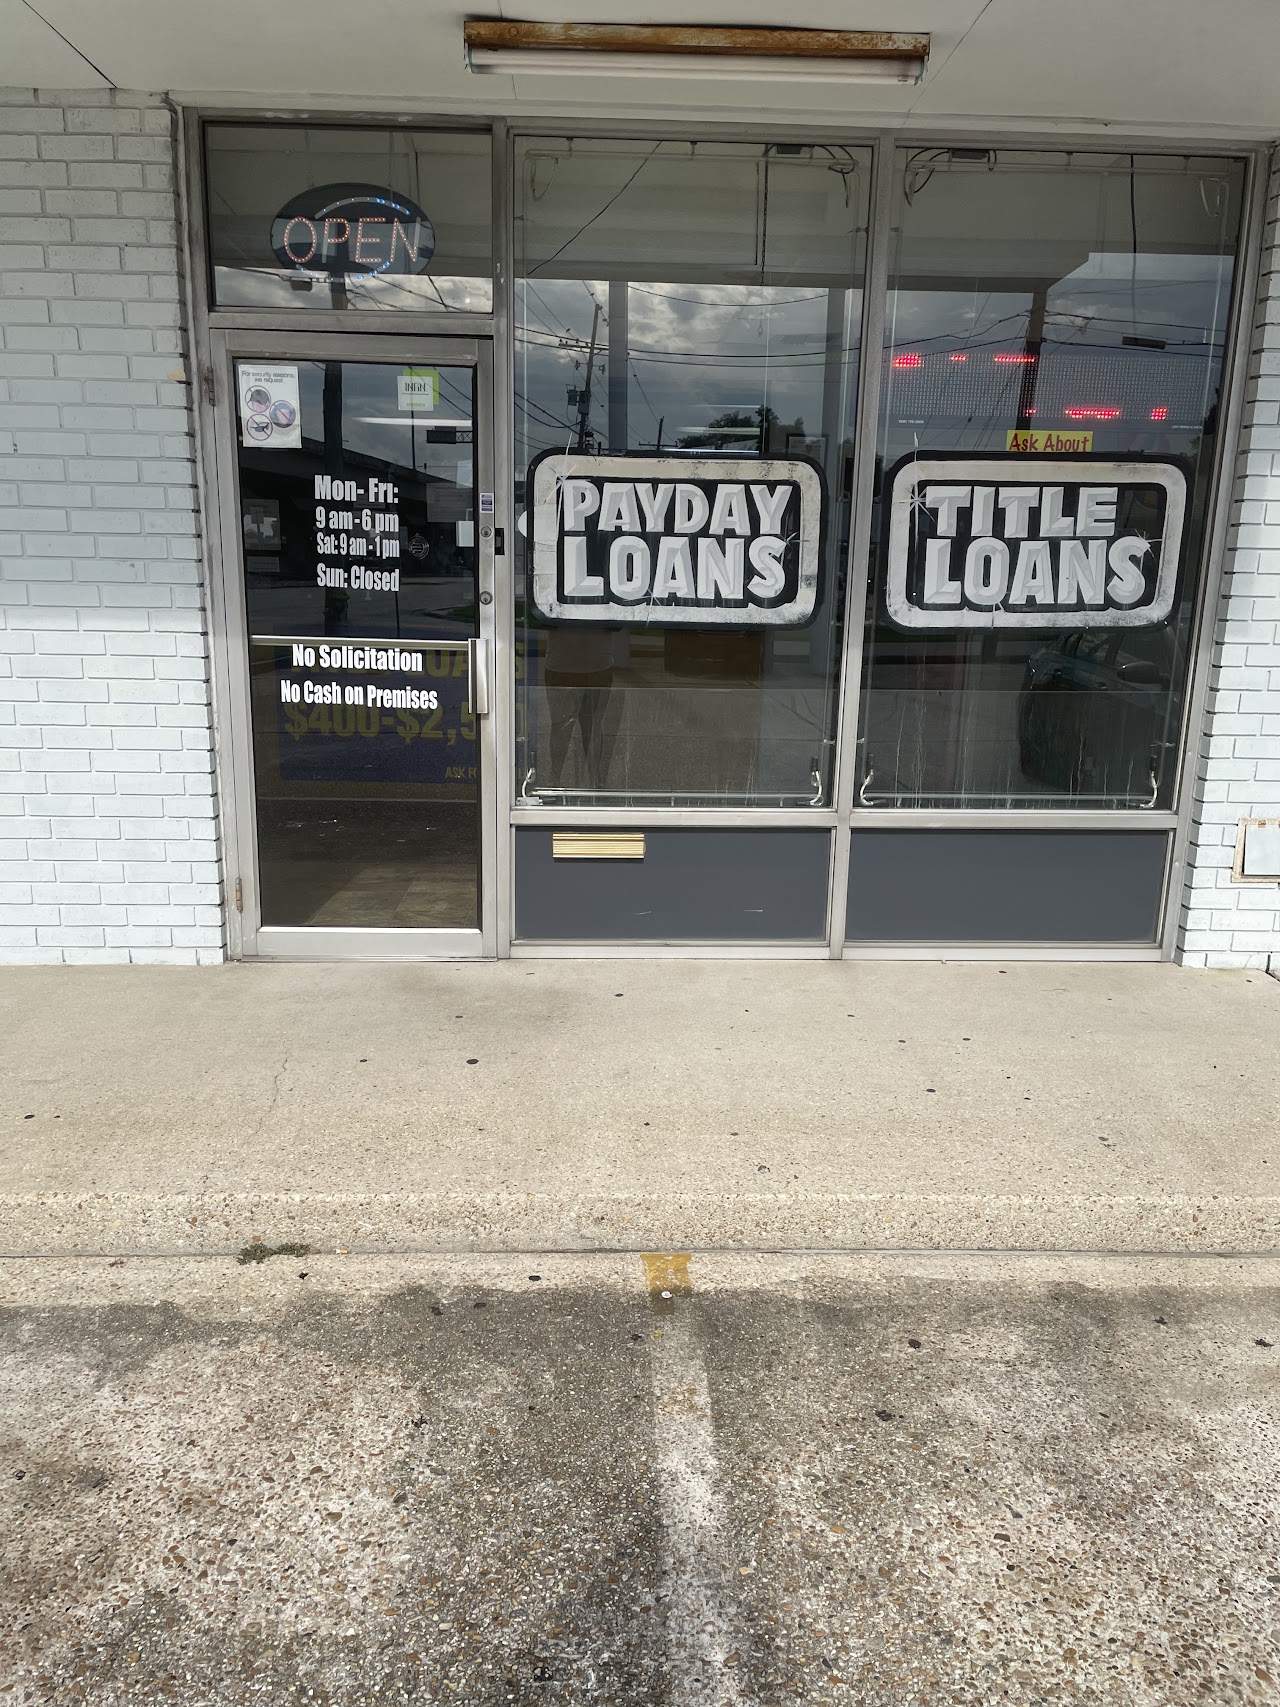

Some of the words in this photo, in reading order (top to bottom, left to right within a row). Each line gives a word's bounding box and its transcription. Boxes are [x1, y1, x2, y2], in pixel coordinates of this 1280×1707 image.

[284, 216, 421, 263] OPEN
[1009, 433, 1039, 451] Ask
[1043, 433, 1089, 452] About
[368, 477, 399, 504] Fri:
[563, 478, 793, 536] PAYDAY
[925, 485, 1119, 538] TITLE
[316, 531, 339, 555] Sat:
[316, 562, 348, 589] Sun:
[350, 565, 400, 592] Closed
[563, 535, 787, 600] LOANS
[923, 535, 1151, 605] LOANS
[292, 643, 315, 667] No
[318, 644, 423, 672] Solicitation
[280, 679, 300, 703] No
[303, 680, 342, 705] Cash
[344, 684, 364, 705] on
[366, 684, 438, 710] Premises
